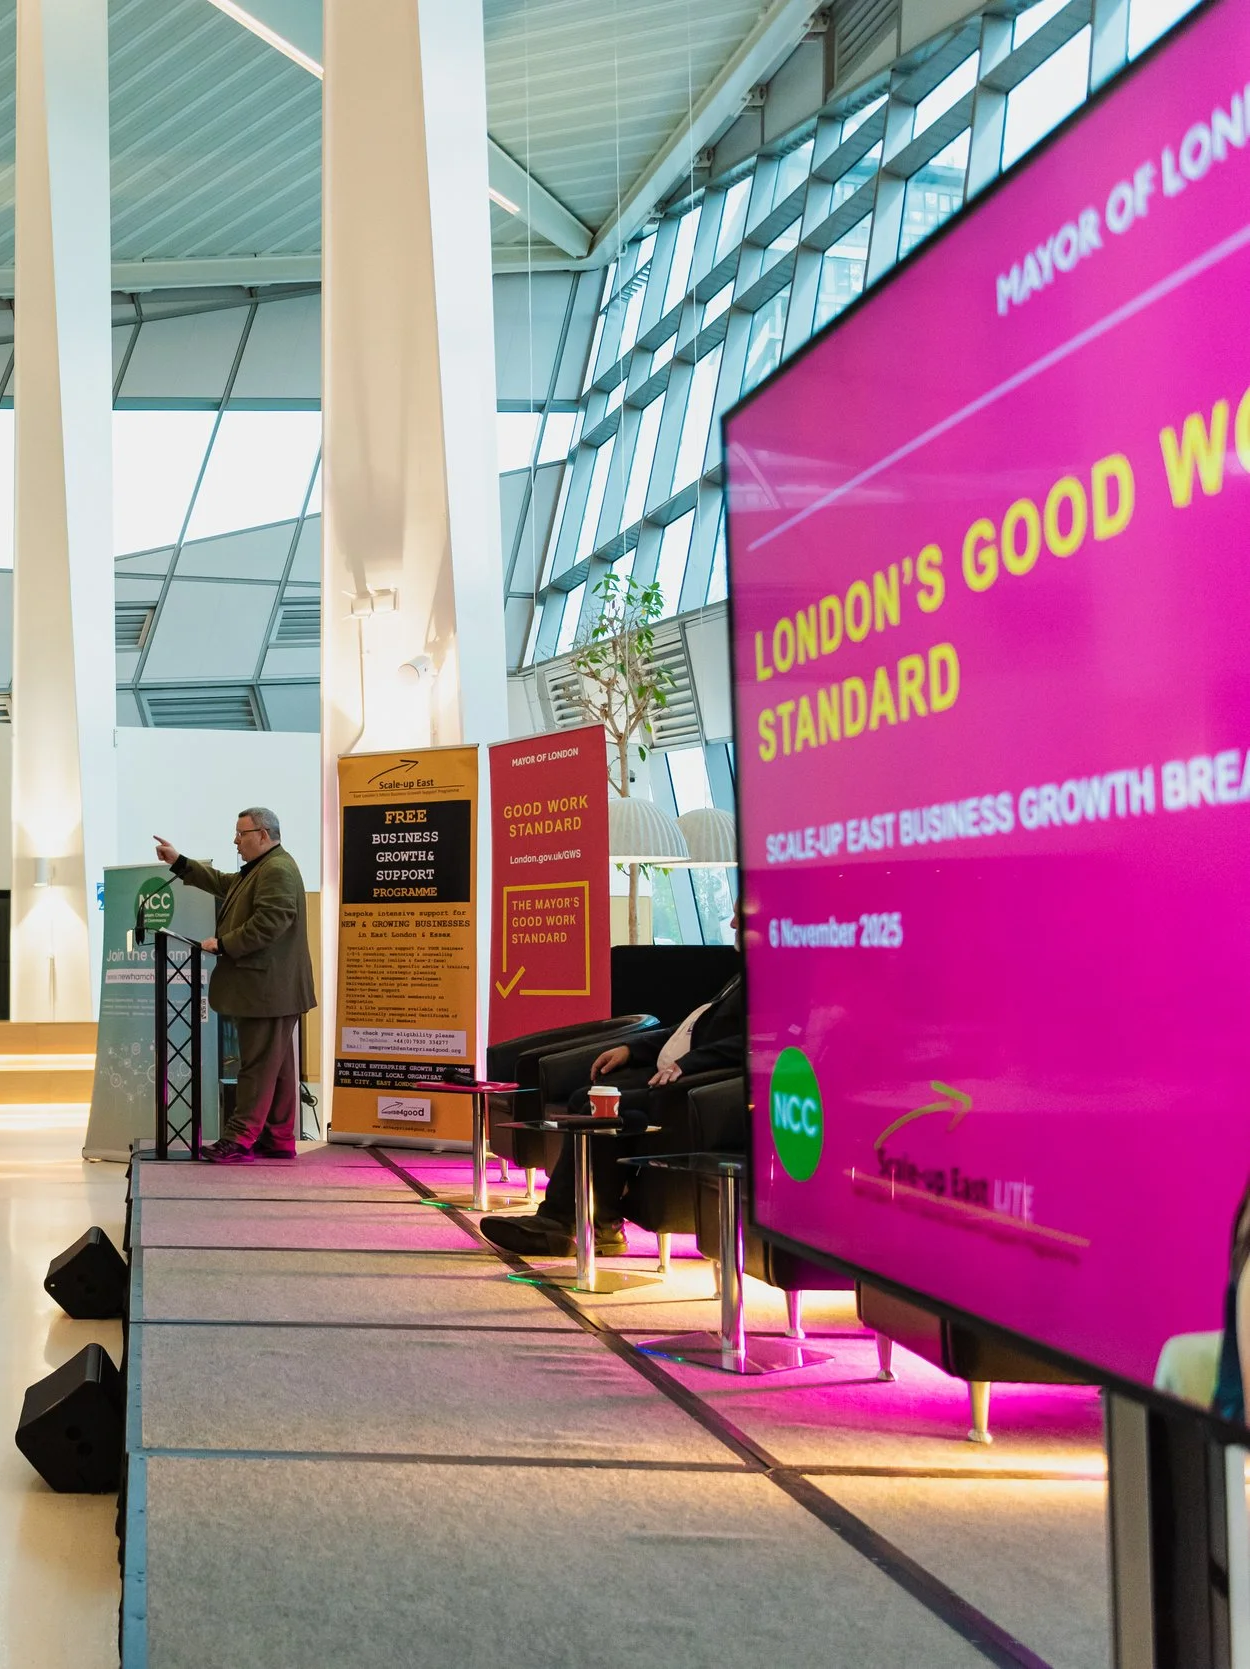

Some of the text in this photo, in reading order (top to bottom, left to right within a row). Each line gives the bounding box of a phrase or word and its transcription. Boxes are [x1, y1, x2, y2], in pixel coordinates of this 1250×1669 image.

[996, 206, 1103, 317] MAYOR
[1105, 162, 1156, 234] OF
[754, 544, 945, 681] LONDON'S
[961, 452, 1136, 592] GOOD
[757, 641, 961, 762] STANDARD
[512, 748, 578, 767] MAYOR OF LONDON
[379, 779, 434, 790] Scale-up East
[504, 795, 588, 819] GOOD WORK
[385, 810, 427, 824] FREE
[765, 823, 844, 864] SCALE-UP
[846, 811, 895, 855] EAST
[901, 791, 1015, 847] BUSINESS
[1019, 767, 1155, 830] GROWTH
[509, 816, 582, 838] STANDARD
[372, 832, 438, 844] BUSINESS
[510, 850, 581, 865] London.gov.uk/GWS
[376, 869, 434, 880] SUPPORT
[373, 887, 438, 897] PROGRAMME
[139, 893, 170, 910] NCC
[512, 897, 580, 910] THE MAYOR'S
[512, 914, 576, 927] GOOD WORK
[512, 932, 567, 944] STANDARD
[769, 912, 902, 949] 6 November 2025
[106, 949, 124, 962] Join
[127, 949, 147, 960] the
[772, 1089, 818, 1138] NCC
